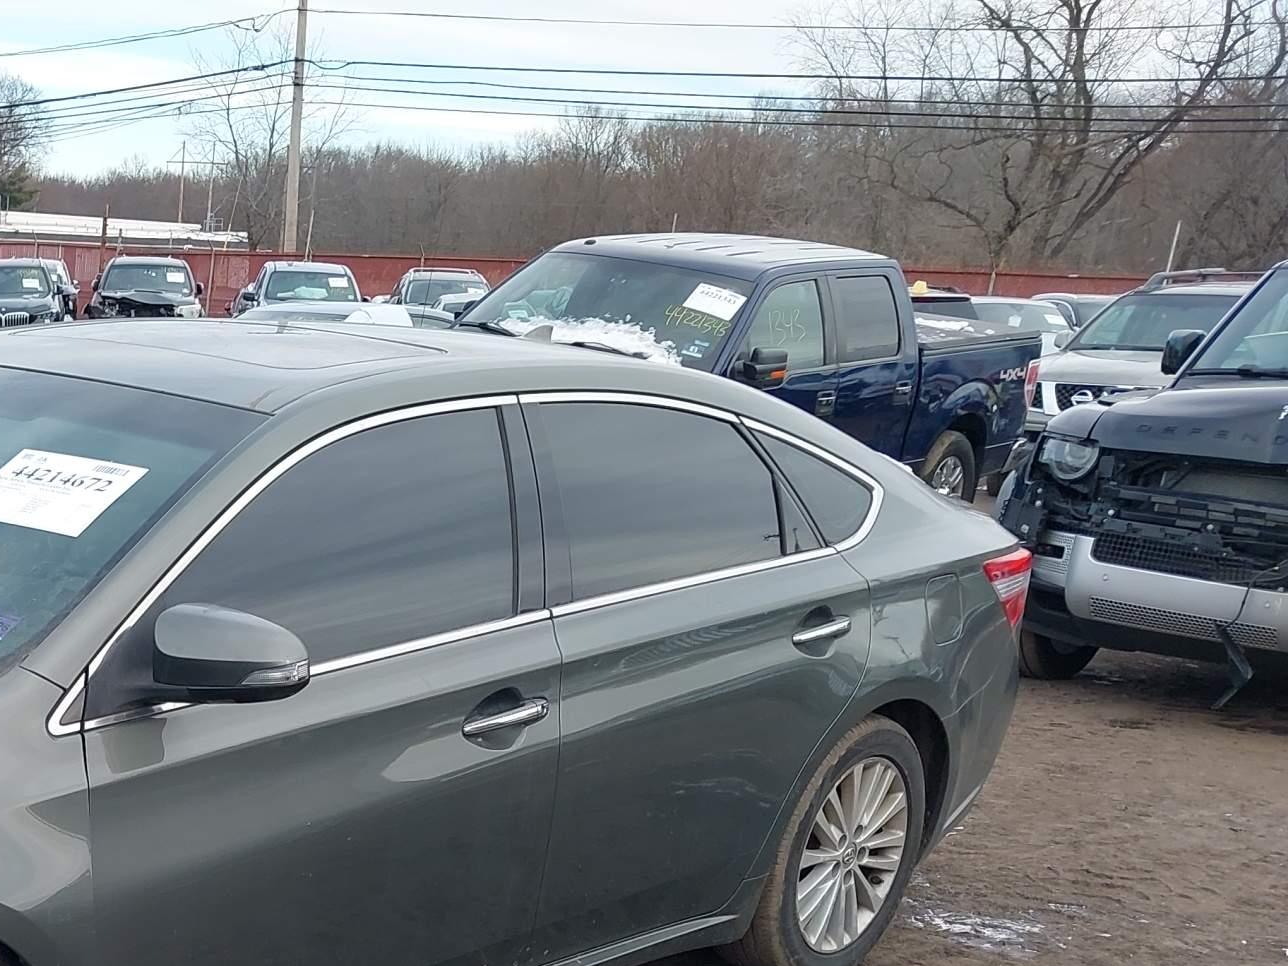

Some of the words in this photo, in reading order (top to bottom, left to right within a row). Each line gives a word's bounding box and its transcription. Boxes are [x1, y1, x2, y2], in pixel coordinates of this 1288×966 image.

[665, 304, 732, 337] 44221343
[768, 309, 807, 346] 1343
[11, 465, 113, 492] 44214672
